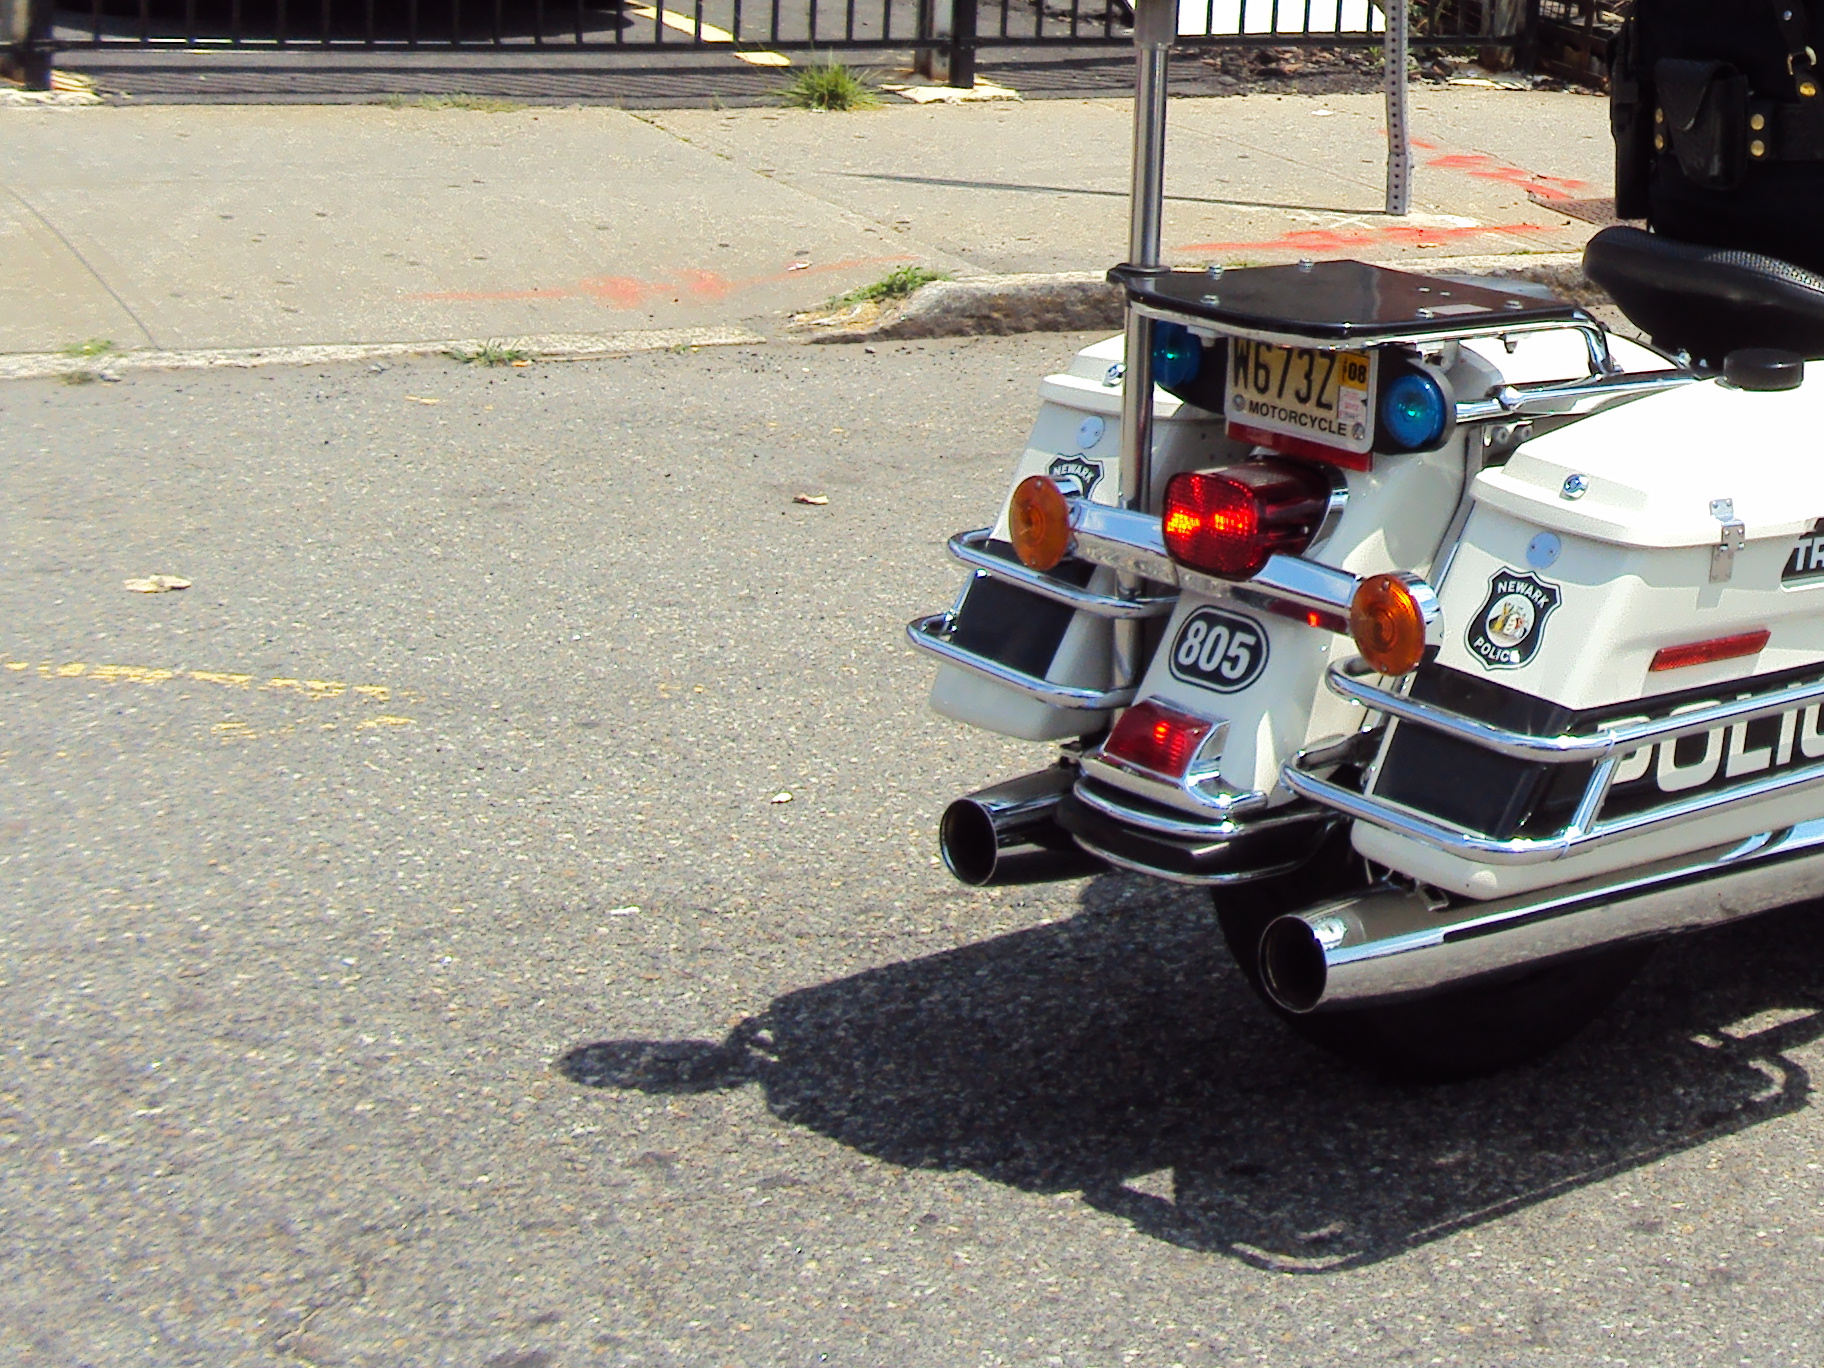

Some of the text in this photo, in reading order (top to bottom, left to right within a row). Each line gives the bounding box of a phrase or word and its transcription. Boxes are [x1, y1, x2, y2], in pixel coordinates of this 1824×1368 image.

[1347, 362, 1367, 384] 08
[1249, 400, 1347, 436] MOTORCYCLE
[1053, 463, 1095, 485] NEWARK
[1497, 581, 1550, 609] NEWARK
[1178, 620, 1257, 680] 805
